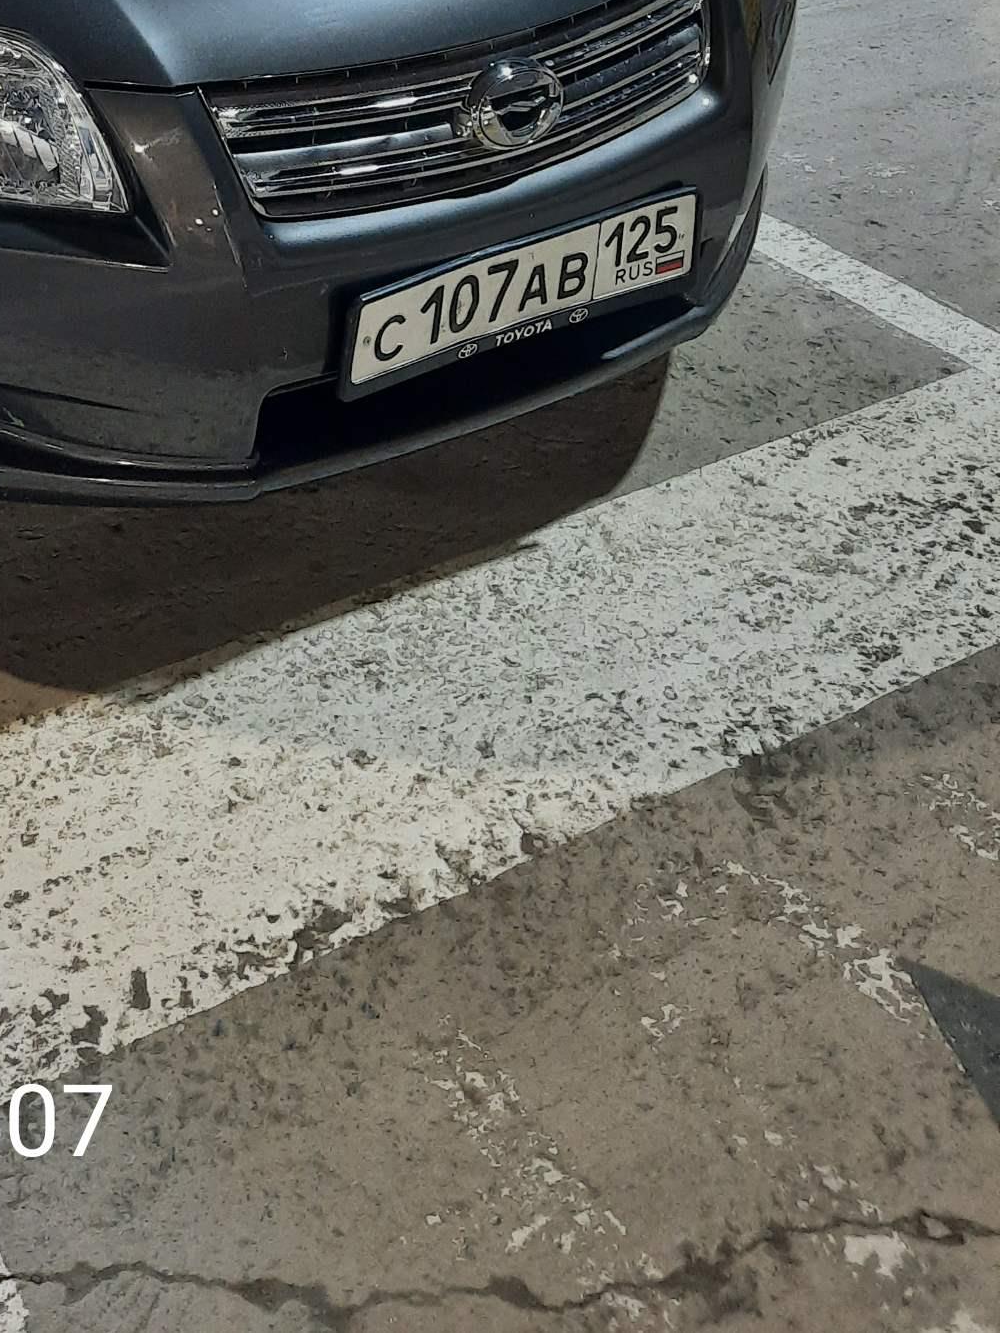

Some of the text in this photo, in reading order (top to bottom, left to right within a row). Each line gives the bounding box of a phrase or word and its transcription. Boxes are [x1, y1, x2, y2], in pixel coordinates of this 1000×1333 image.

[374, 206, 679, 362] С107АВ 125
[615, 263, 654, 285] RUS
[495, 319, 553, 347] TOYOTA
